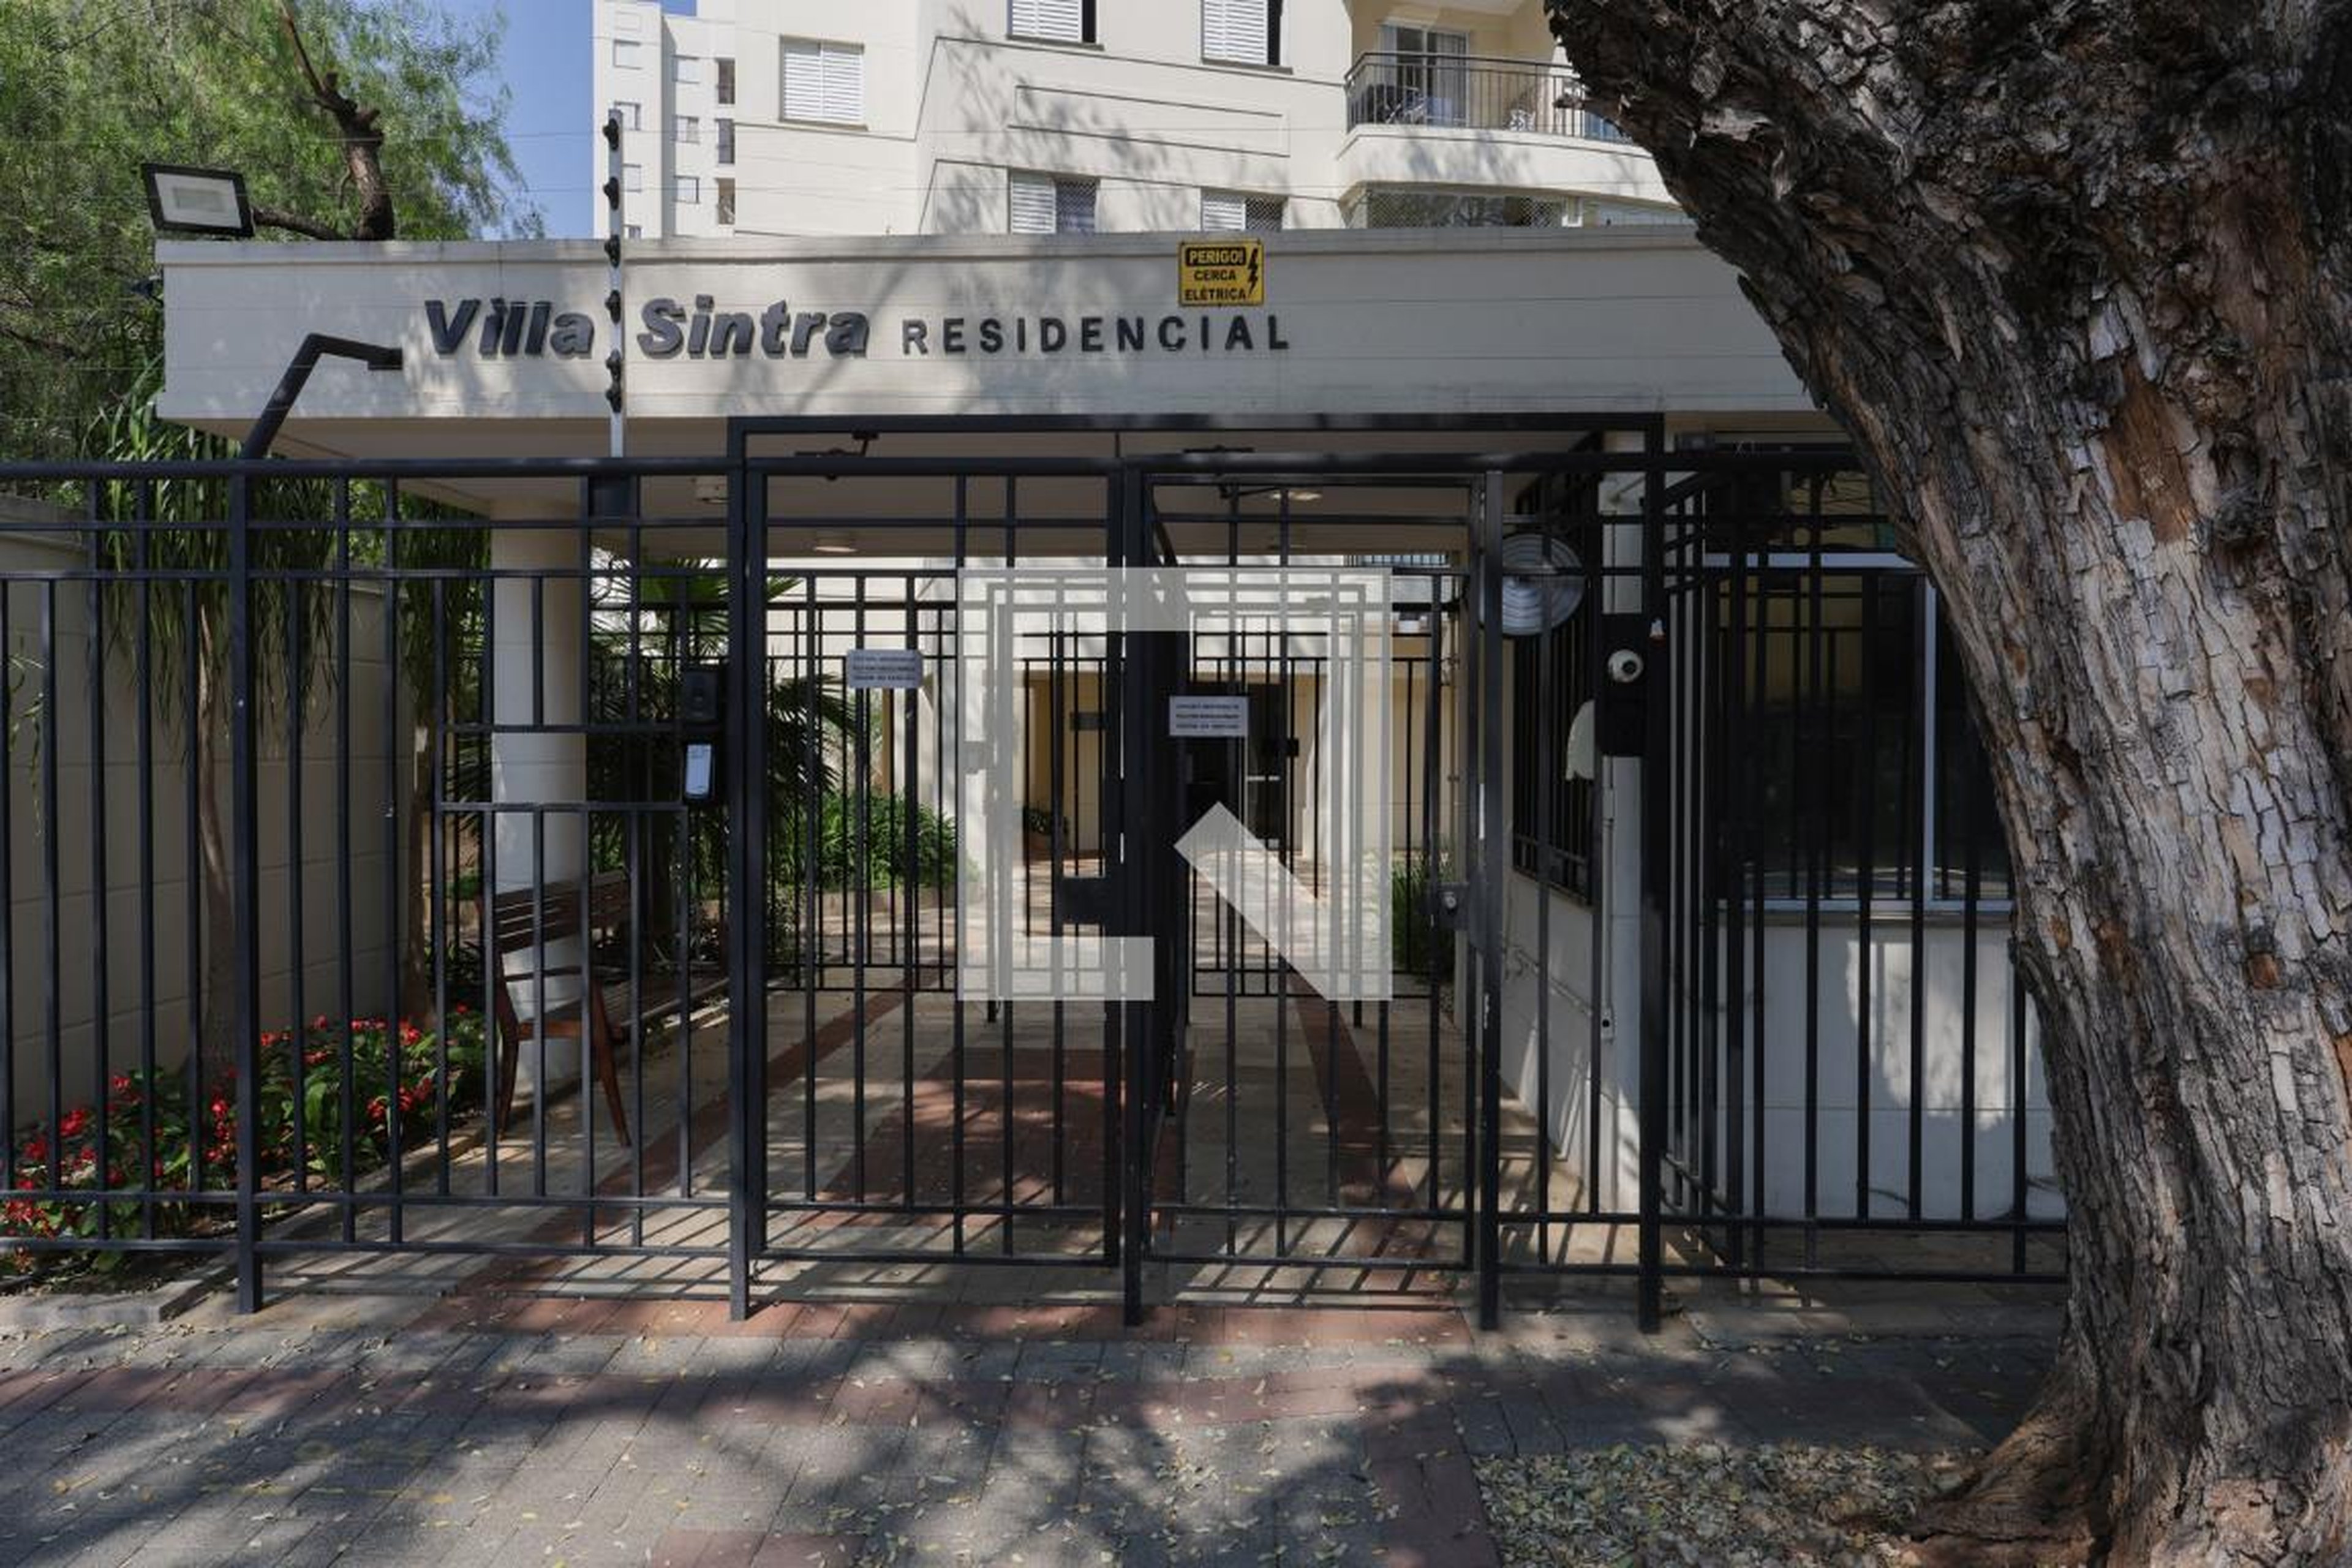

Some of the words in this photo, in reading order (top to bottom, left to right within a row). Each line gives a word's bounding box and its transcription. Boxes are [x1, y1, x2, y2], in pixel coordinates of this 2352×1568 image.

[1188, 249, 1244, 265] PERIGO!
[1194, 269, 1237, 281] CERCA
[1185, 286, 1247, 301] ELÉTRICA
[424, 297, 594, 357] Villa
[636, 294, 870, 357] Sintra
[902, 315, 1290, 355] RESIDENCIAL
